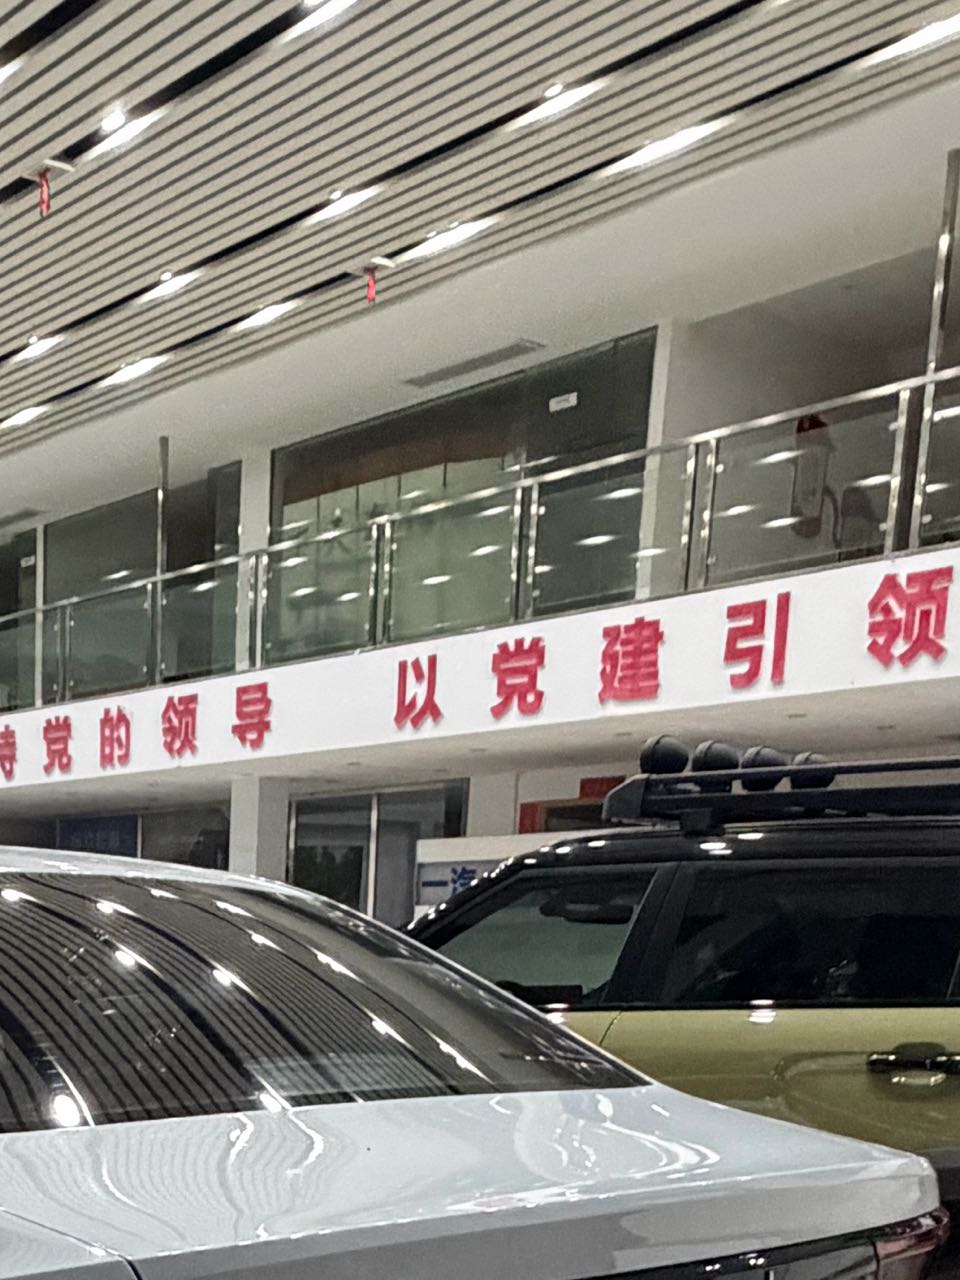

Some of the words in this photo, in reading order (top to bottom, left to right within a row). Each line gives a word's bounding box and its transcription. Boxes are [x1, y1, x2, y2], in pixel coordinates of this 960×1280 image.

[393, 566, 954, 731] 以党建引领
